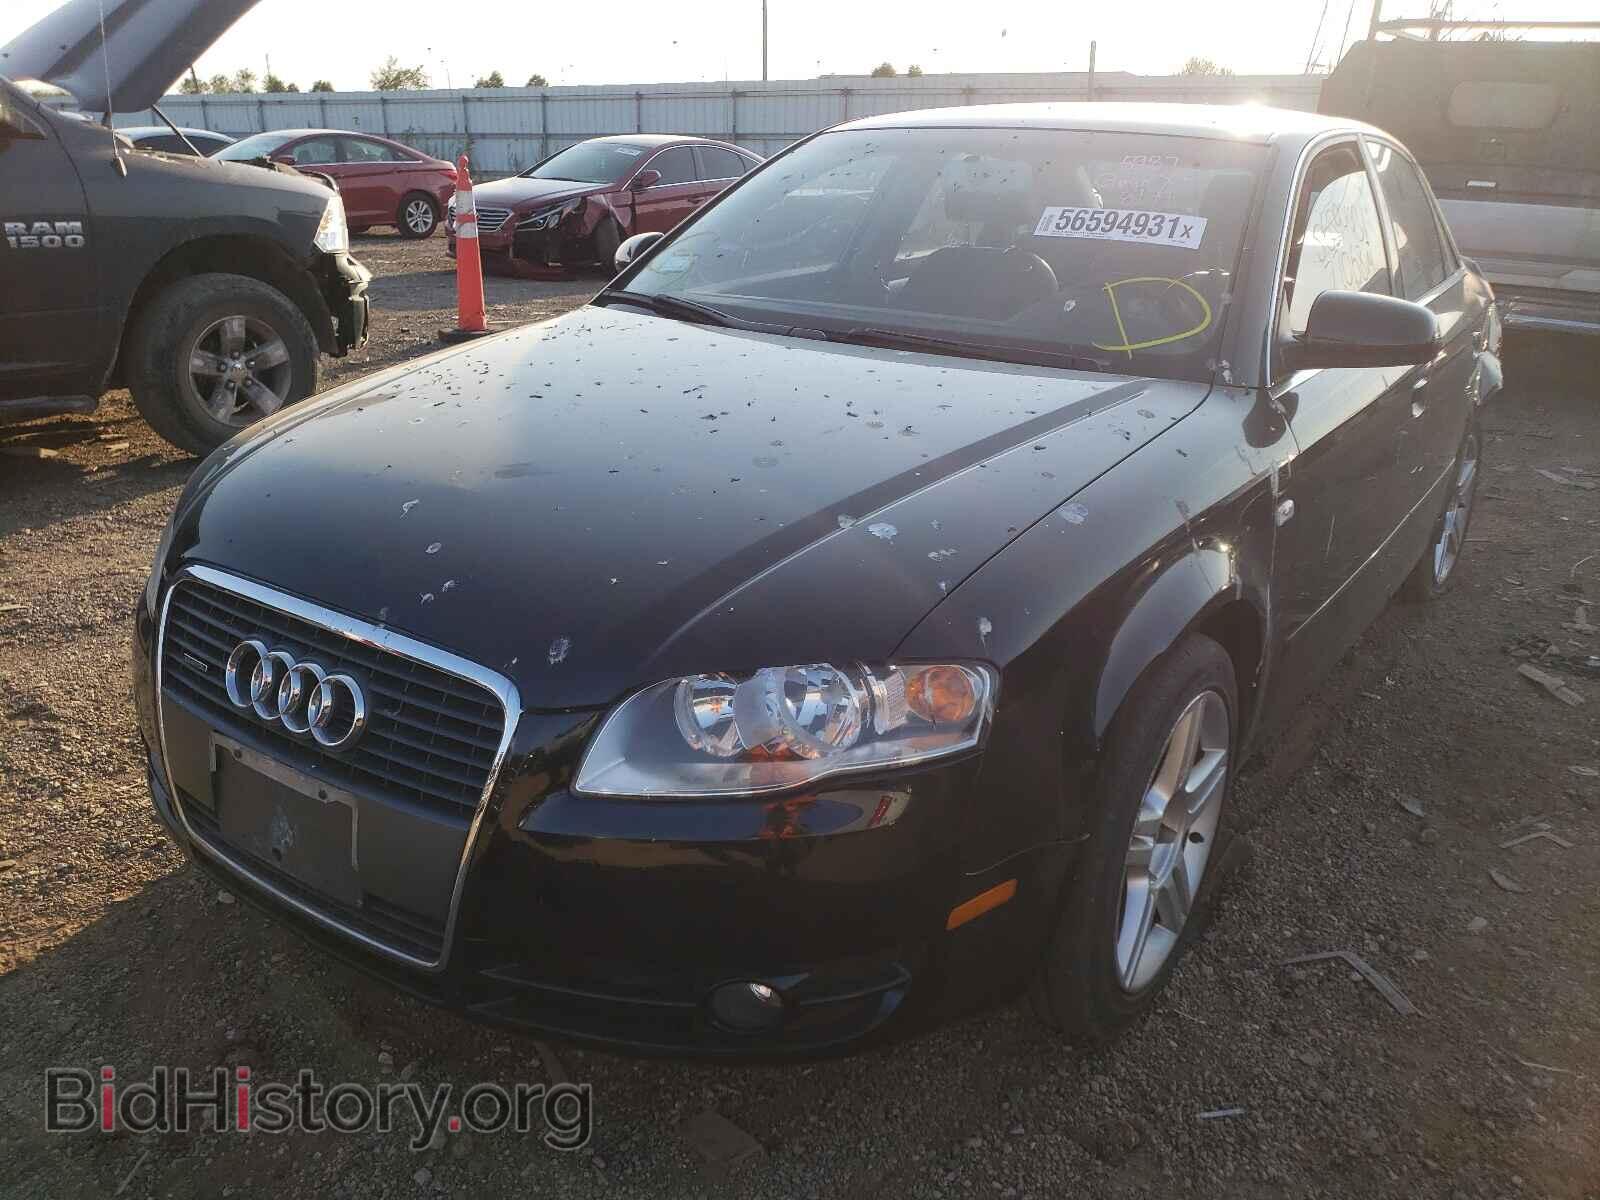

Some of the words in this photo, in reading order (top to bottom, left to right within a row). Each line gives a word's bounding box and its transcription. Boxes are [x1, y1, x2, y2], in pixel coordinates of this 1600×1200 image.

[4, 221, 82, 235] RAM
[7, 235, 86, 248] 1500
[1091, 276, 1212, 360] D
